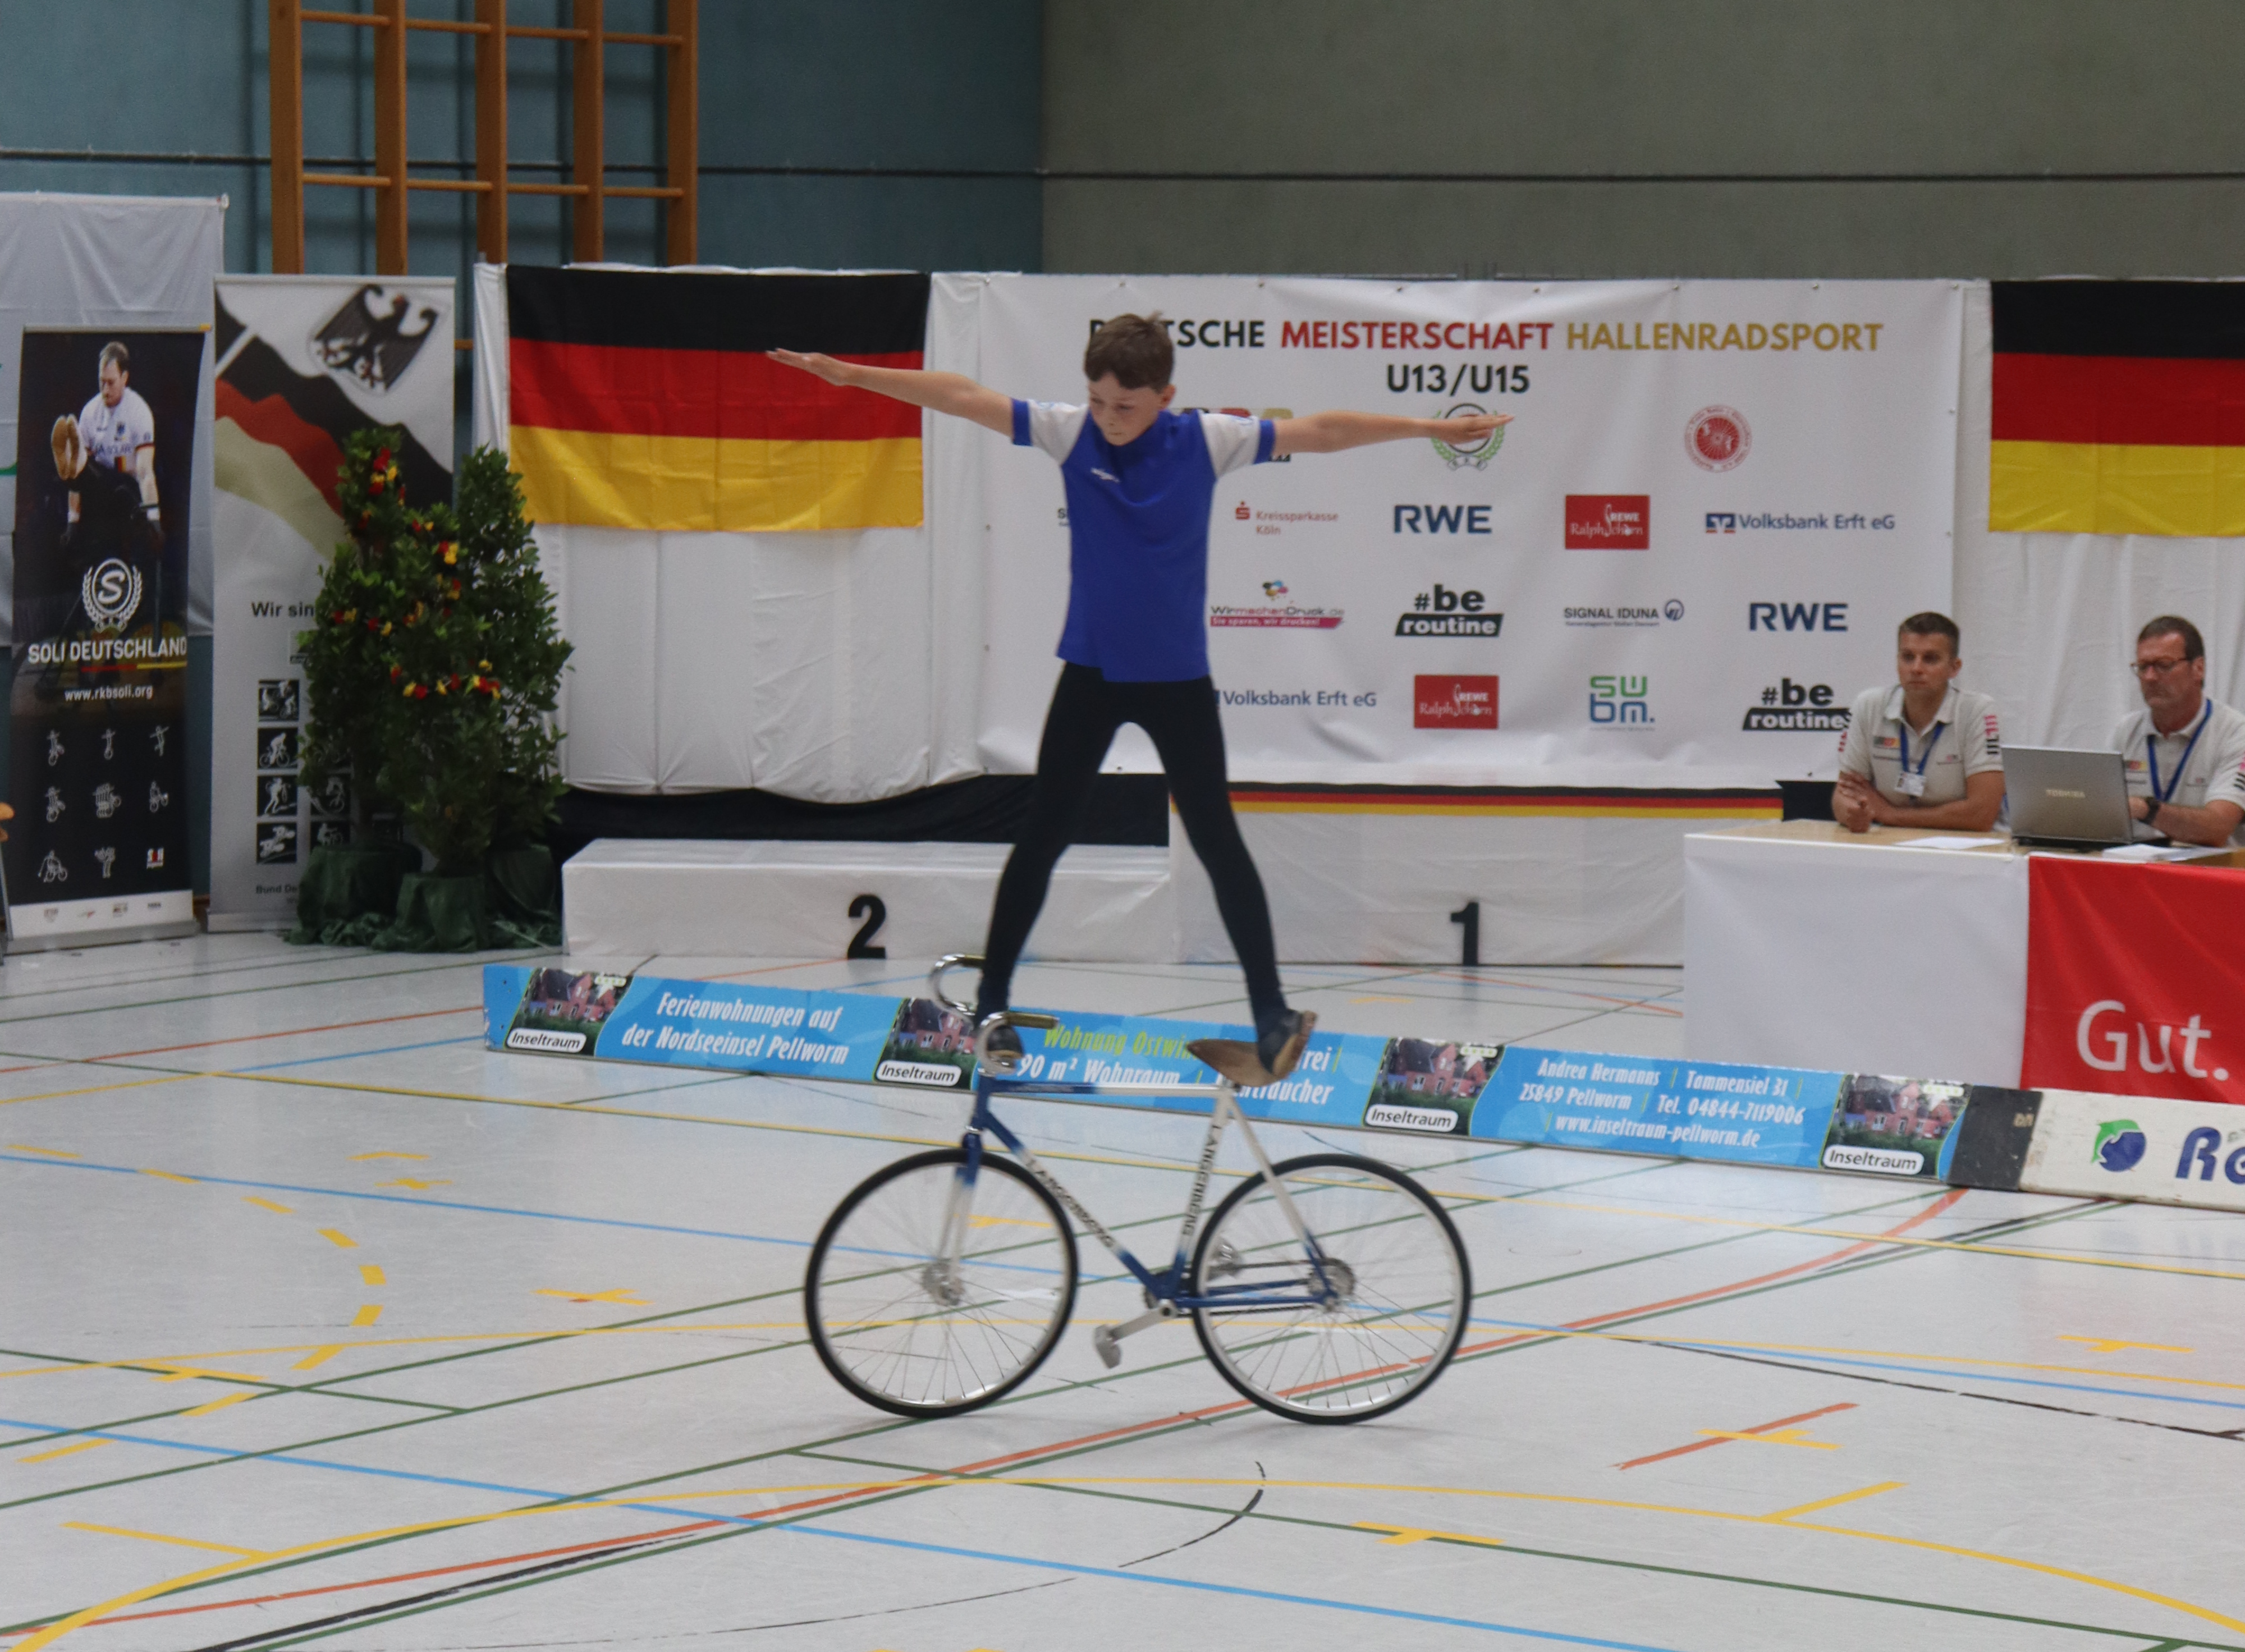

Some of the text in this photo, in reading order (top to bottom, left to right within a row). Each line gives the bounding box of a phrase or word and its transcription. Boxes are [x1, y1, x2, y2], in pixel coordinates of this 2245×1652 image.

[1090, 320, 1884, 351] SCHE MEISTERSCHAFT HALLENRADSPORT
[1387, 364, 1530, 397] U13/U15
[1256, 511, 1339, 522] Kreissparkasse
[1394, 504, 1492, 534] RWE
[1610, 512, 1639, 522] REWE
[1739, 513, 1895, 530] Volksbank Erft eG
[1256, 525, 1281, 535] Köln
[1570, 522, 1604, 539] Ralph
[251, 601, 315, 617] Wir sin
[1415, 584, 1485, 612] #be
[1564, 607, 1660, 618] SIGNAL IDUNA
[1749, 603, 1848, 631] RWE
[1403, 616, 1497, 635] routine
[28, 636, 187, 664] SOLI DEUTSCHLAND
[65, 685, 153, 701] www.rkbsoli.org
[1223, 689, 1377, 707] Volksbank Erft eG
[1460, 692, 1488, 701] REWE
[1761, 677, 1834, 706] #be
[1419, 701, 1453, 718] Ralph
[1750, 711, 1845, 729] routine
[847, 894, 886, 959] 2
[1451, 901, 1479, 966] 1
[656, 992, 843, 1032] Ferienwohnungen auf
[511, 1032, 581, 1050] Inseltraum
[622, 1023, 849, 1064] der Nordseeinsel Pellworm
[1044, 1024, 1128, 1056] Wohnung
[1132, 1031, 1207, 1061] Ostwin
[2077, 999, 2230, 1081] Gut.
[881, 1064, 955, 1082] Inseltraum
[1016, 1053, 1045, 1079] 90
[1047, 1057, 1078, 1081] m²
[1083, 1058, 1180, 1084] Wohnraum
[1537, 1058, 1789, 1097] Andrea Hermanns Tammensiel 31
[1519, 1082, 1807, 1125] 25849 Pellworm Tel. 04844-7119006
[1371, 1108, 1453, 1128] Inseltraum
[1555, 1115, 1761, 1148] www.inseltraum-pellworm.de
[1829, 1149, 1917, 1171] Inseltraum
